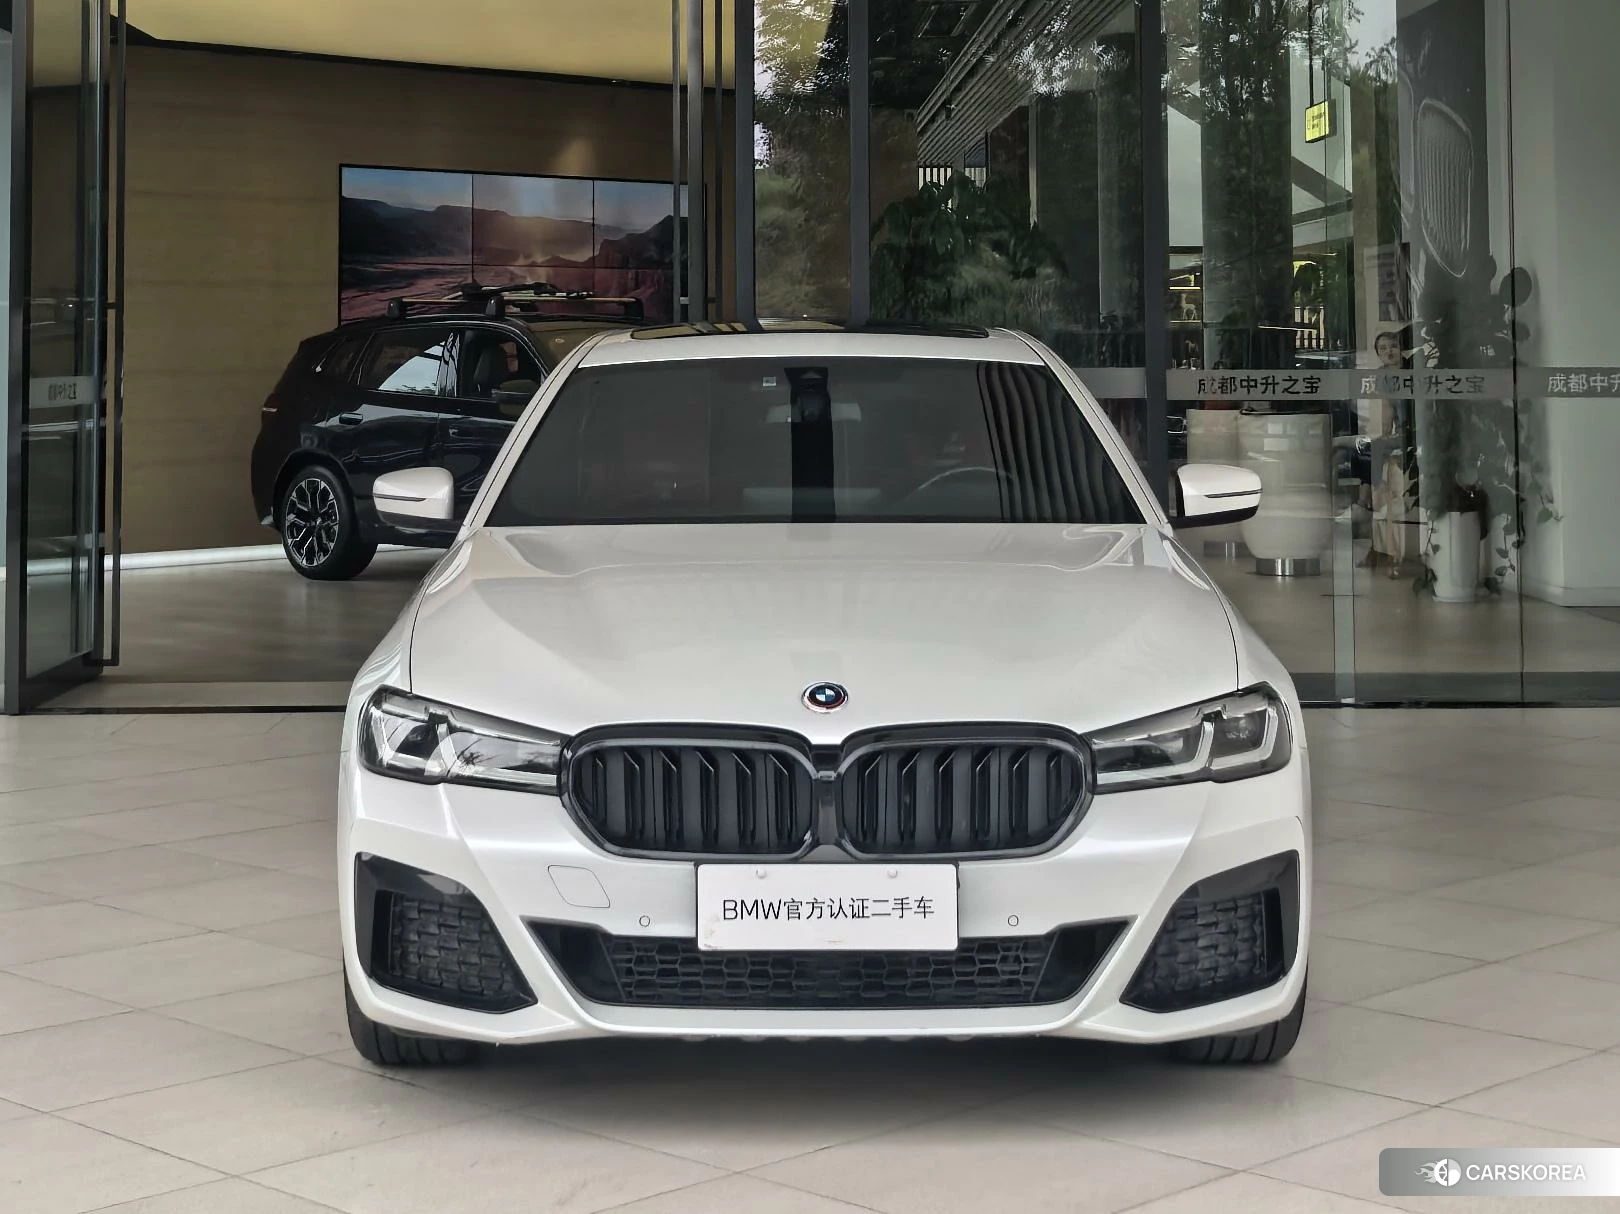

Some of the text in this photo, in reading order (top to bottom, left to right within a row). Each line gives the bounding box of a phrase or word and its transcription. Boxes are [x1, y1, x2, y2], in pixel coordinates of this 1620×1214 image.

[1197, 375, 1322, 395] 成都中升之宝
[722, 896, 935, 921] BMW官方认证二手车
